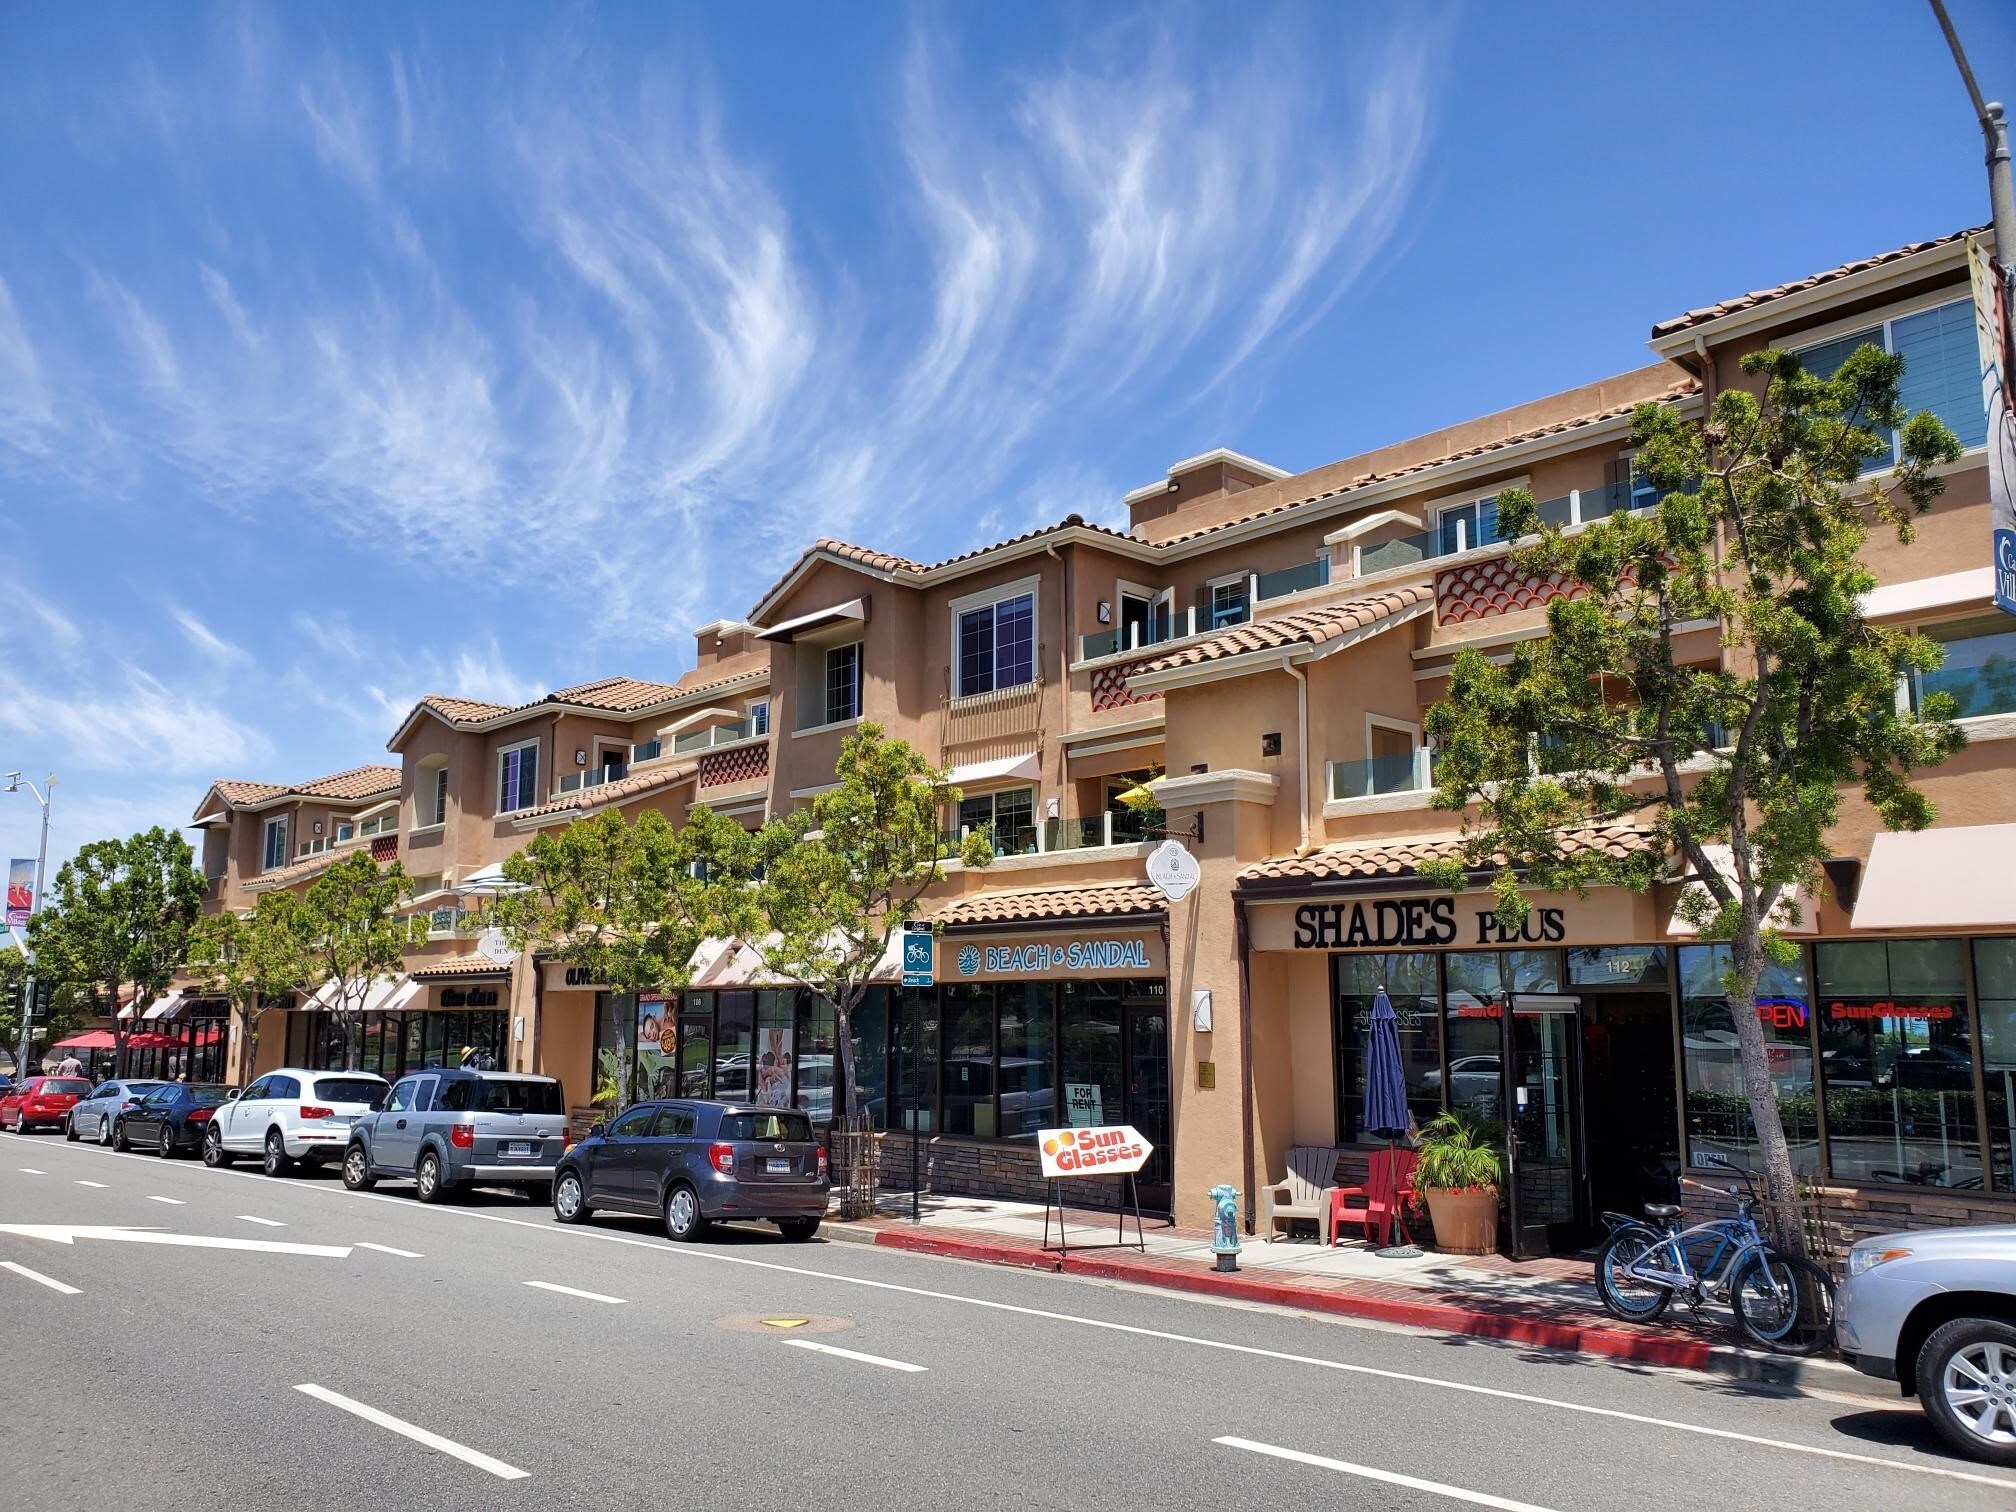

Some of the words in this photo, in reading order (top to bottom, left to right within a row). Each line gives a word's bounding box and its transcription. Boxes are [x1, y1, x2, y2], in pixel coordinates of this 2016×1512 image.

[1294, 897, 1457, 949] SHADES
[1475, 908, 1566, 944] PLUS
[985, 943, 1050, 972] BEACH
[1052, 946, 1066, 965] &
[1066, 938, 1150, 970] SANDAL
[1605, 960, 1631, 973] 112
[1148, 985, 1164, 996] 110
[1359, 1010, 1421, 1026] SUSSES
[1756, 1006, 1805, 1028] PEN
[1831, 1001, 1953, 1019] SunGlasses
[1074, 1087, 1092, 1098] FOR
[1072, 1099, 1096, 1110] RENT
[1078, 1130, 1126, 1151] Sun
[1056, 1143, 1143, 1171] Glasses
